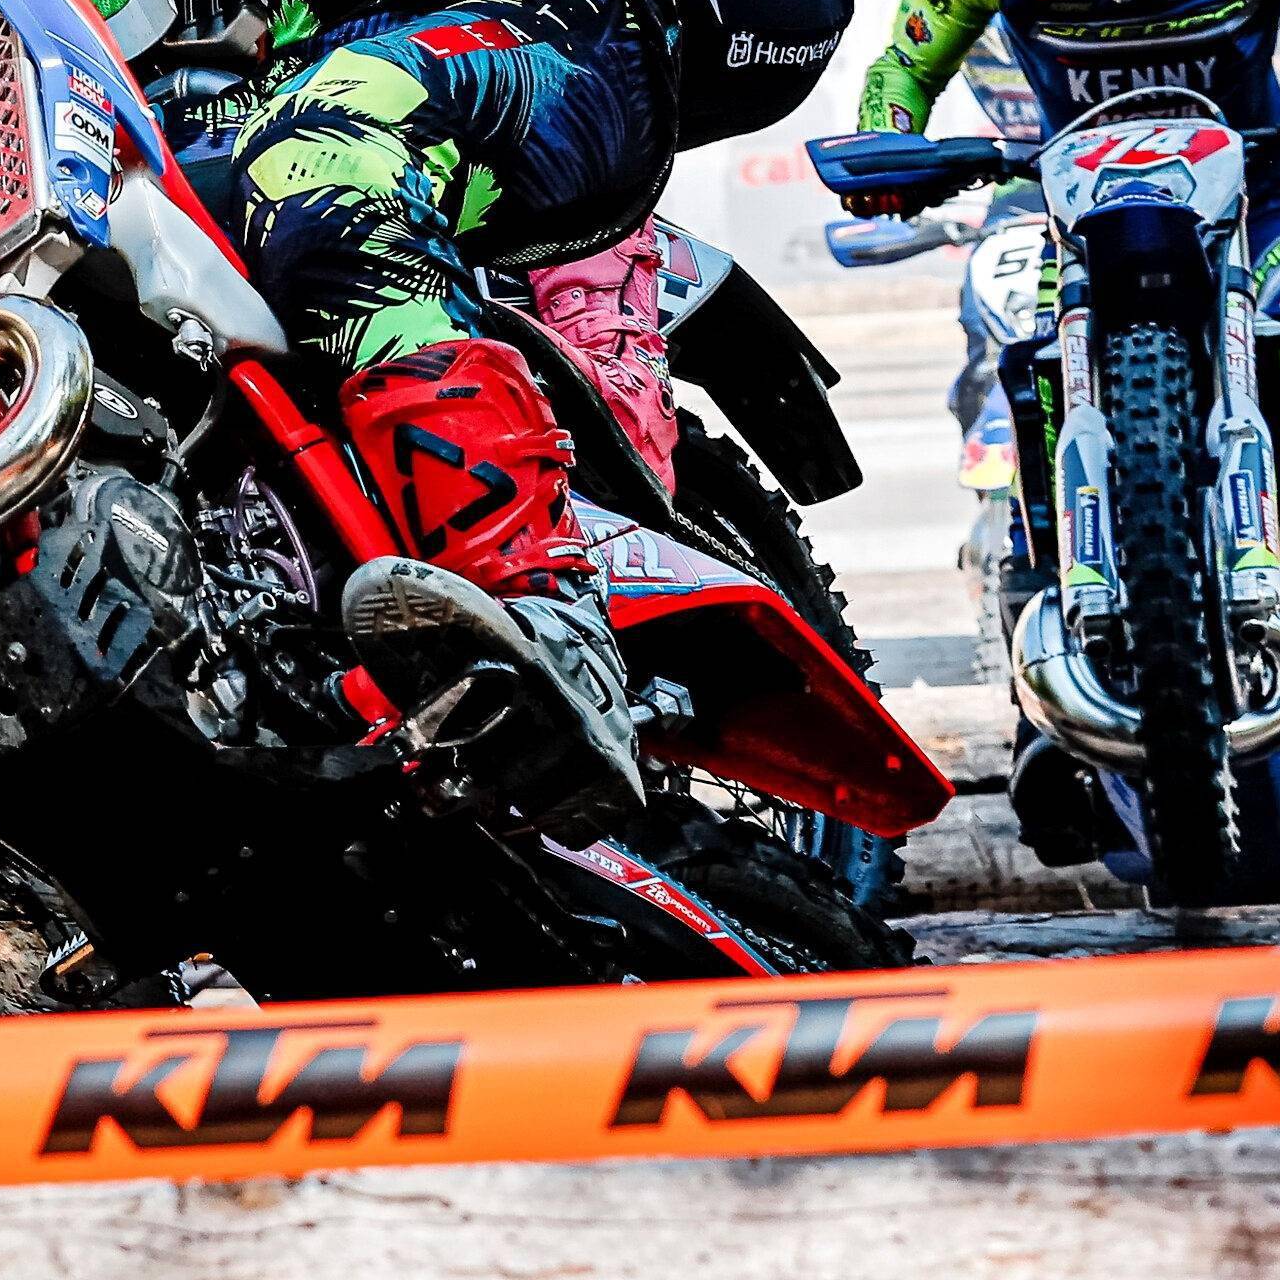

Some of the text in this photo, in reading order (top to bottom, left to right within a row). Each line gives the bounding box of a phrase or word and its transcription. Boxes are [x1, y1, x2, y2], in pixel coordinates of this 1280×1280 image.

[1067, 57, 1217, 104] KENNY
[71, 113, 110, 151] ODM
[1100, 128, 1199, 163] 74
[612, 991, 1037, 1129] KTM
[39, 1020, 464, 1155] KTM
